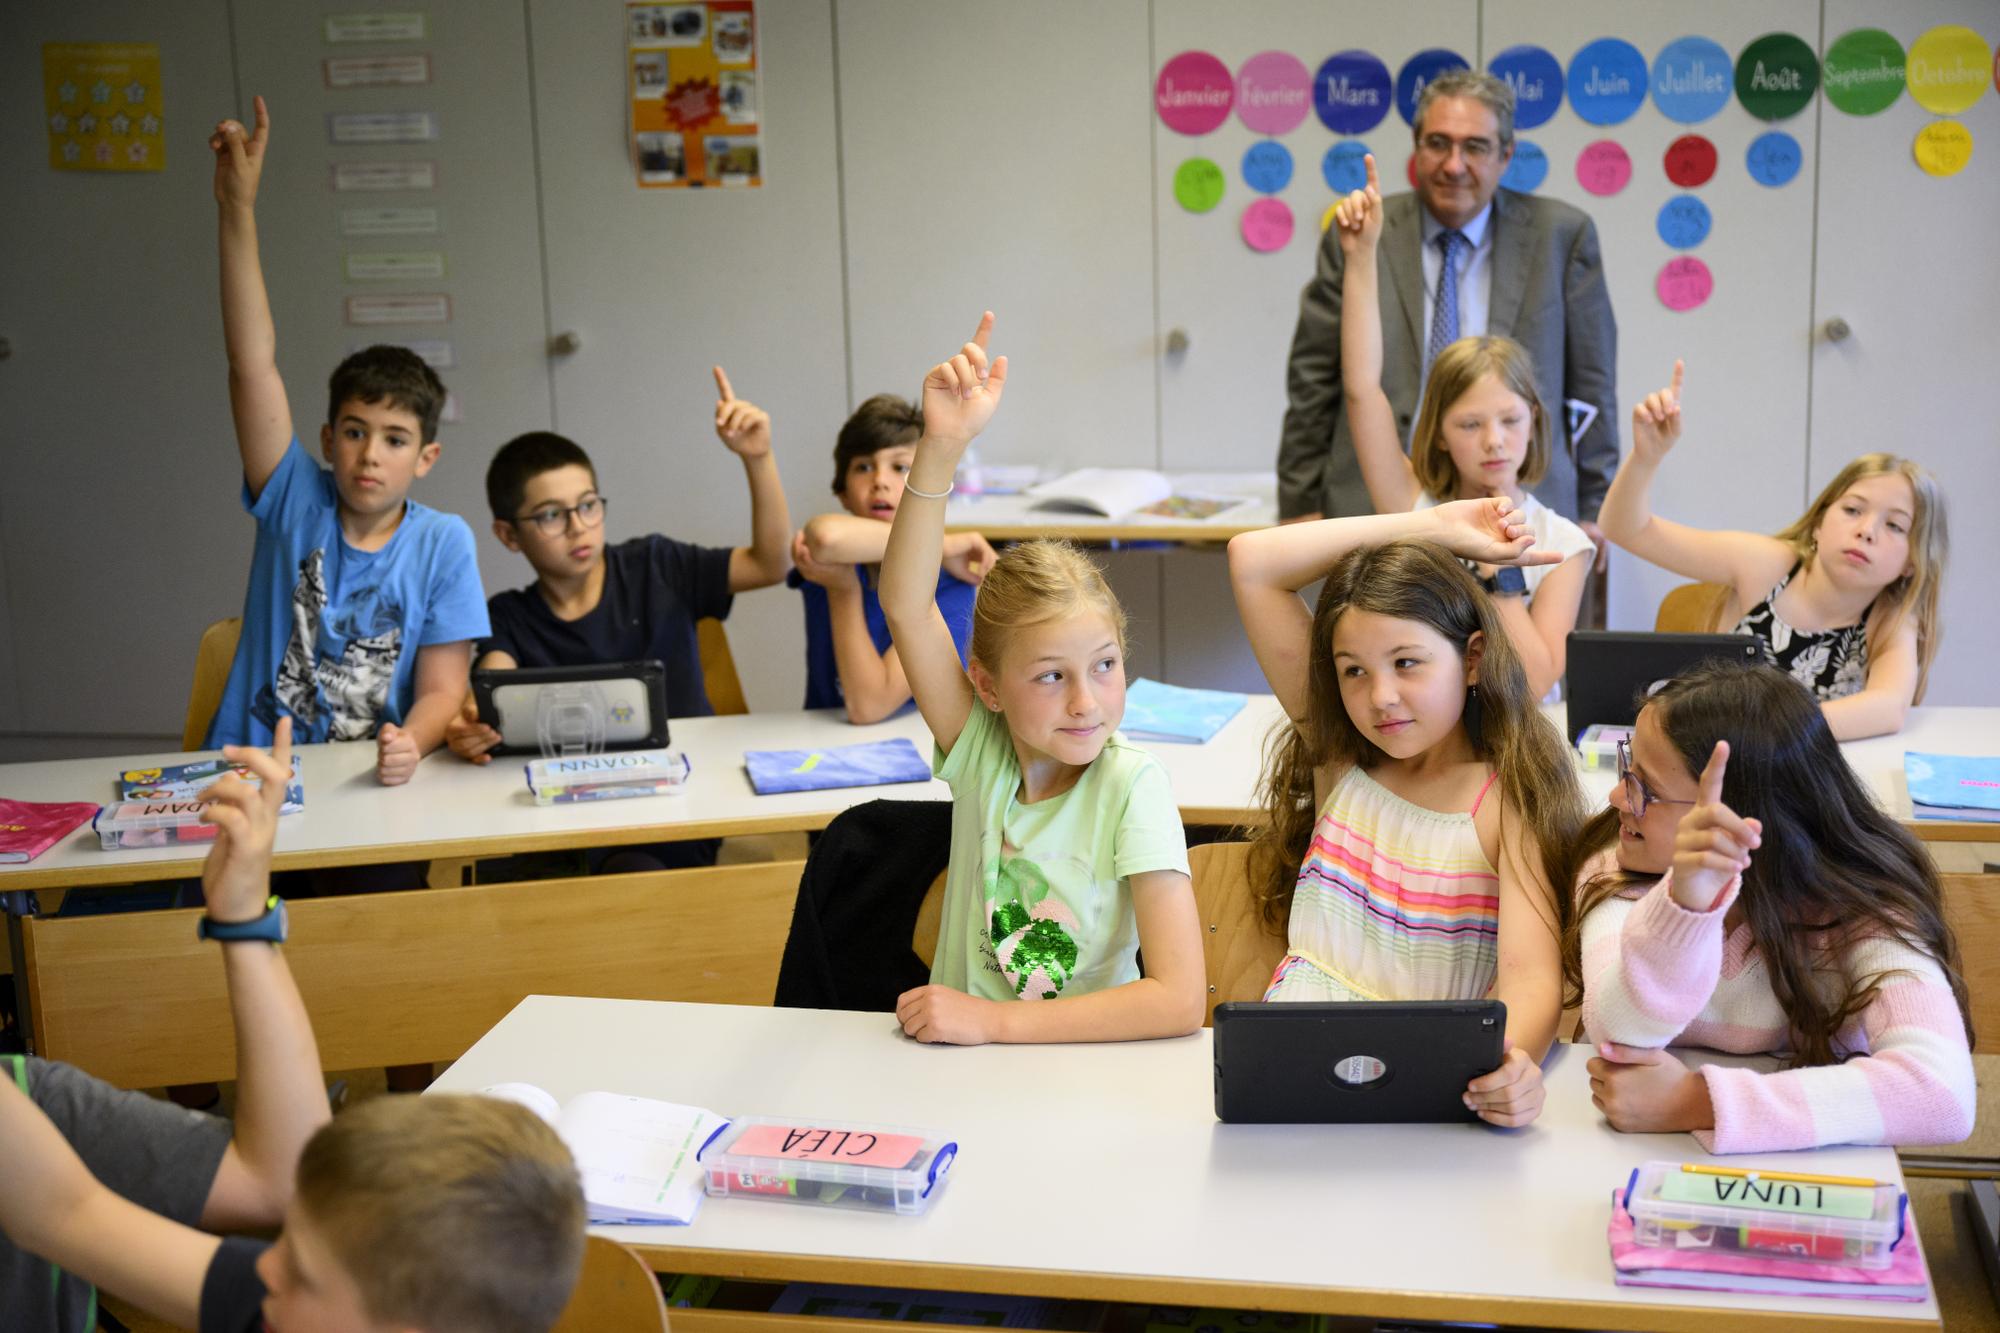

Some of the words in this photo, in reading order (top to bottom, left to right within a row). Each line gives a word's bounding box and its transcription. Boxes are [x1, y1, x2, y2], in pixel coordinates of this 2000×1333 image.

[1504, 70, 1544, 101] Mai
[1583, 65, 1631, 96] Juin
[1658, 60, 1725, 95] Juillet
[1751, 60, 1802, 91] Août
[1823, 56, 1906, 90] Septembre
[1911, 56, 1985, 86] Octobre
[1159, 77, 1231, 108] Janvier
[1327, 76, 1380, 106] Mars
[560, 755, 654, 773] YOANN
[143, 802, 207, 815] DAM
[780, 1127, 877, 1158] CLÉA
[1714, 1176, 1823, 1209] LUNA
